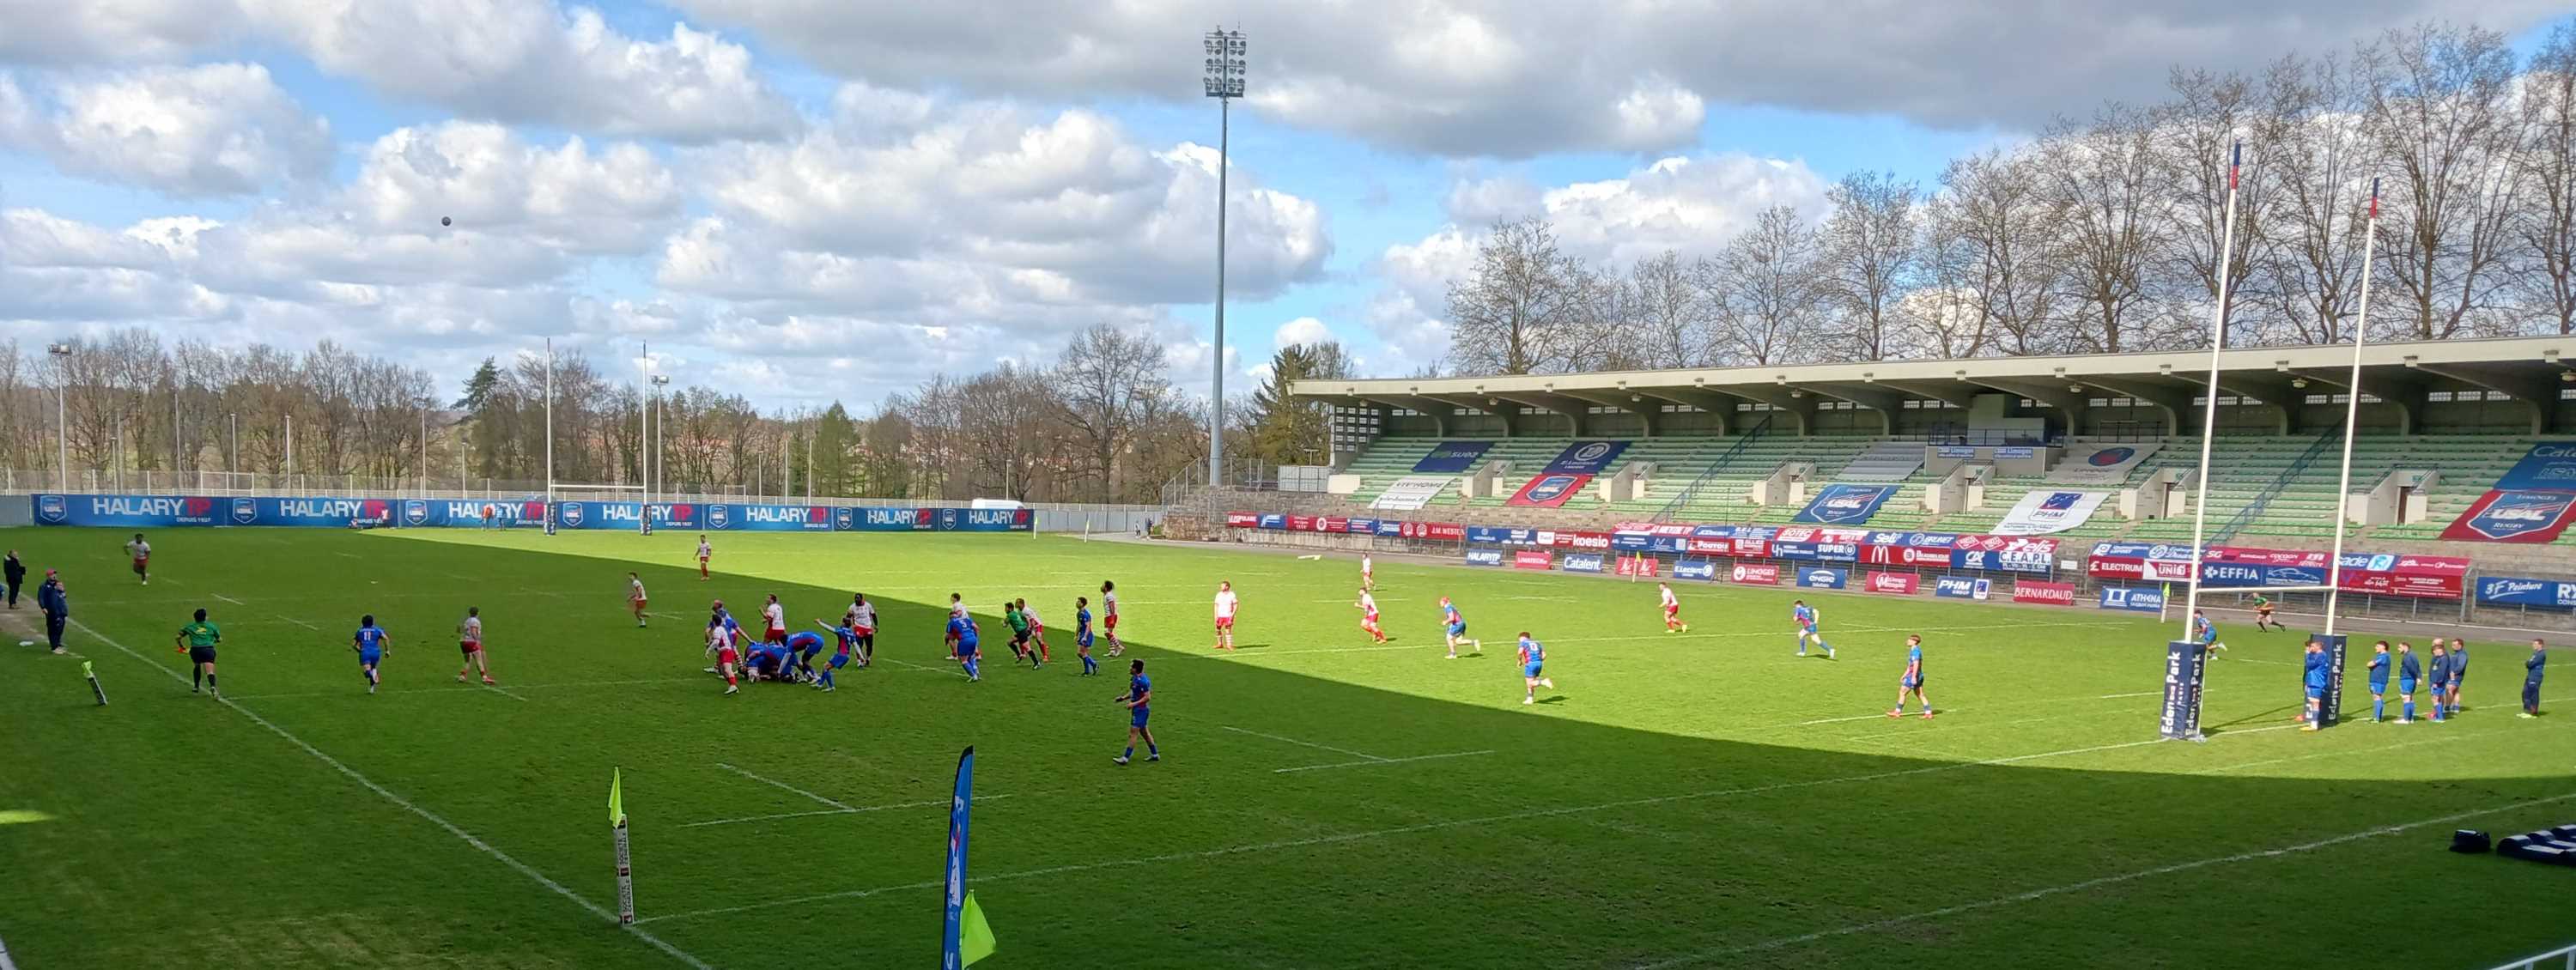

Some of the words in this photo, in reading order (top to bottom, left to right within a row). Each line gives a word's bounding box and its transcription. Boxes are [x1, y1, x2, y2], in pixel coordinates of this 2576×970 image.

[92, 498, 185, 516] HALARY
[186, 498, 213, 515] TP
[280, 500, 362, 517] HALARY
[448, 501, 524, 518] HALRY
[602, 504, 672, 520] HALRY
[672, 505, 693, 520] TP
[745, 506, 811, 523] HALARY
[2490, 508, 2546, 520] USAL
[867, 510, 918, 524] HALARY
[969, 510, 1014, 524] HALARY
[1573, 534, 1609, 548] koesio
[1818, 543, 1844, 554] SUPER
[2023, 539, 2056, 554] elis
[1564, 556, 1602, 571] Catalent
[2101, 562, 2143, 572] ELECTRUM
[2220, 567, 2259, 580] EFFIA
[1938, 580, 1972, 590] PHM
[2507, 582, 2543, 591] Peinture
[2014, 587, 2073, 600] BERNARDAUD
[2131, 593, 2161, 603] ATHENA
[364, 632, 371, 640] 11
[2332, 644, 2342, 673] Park
[2166, 652, 2181, 684] Park
[2190, 653, 2201, 685] Park
[2329, 691, 2338, 720] Eden
[2160, 701, 2175, 734] Eden
[2185, 704, 2197, 736] Eden
